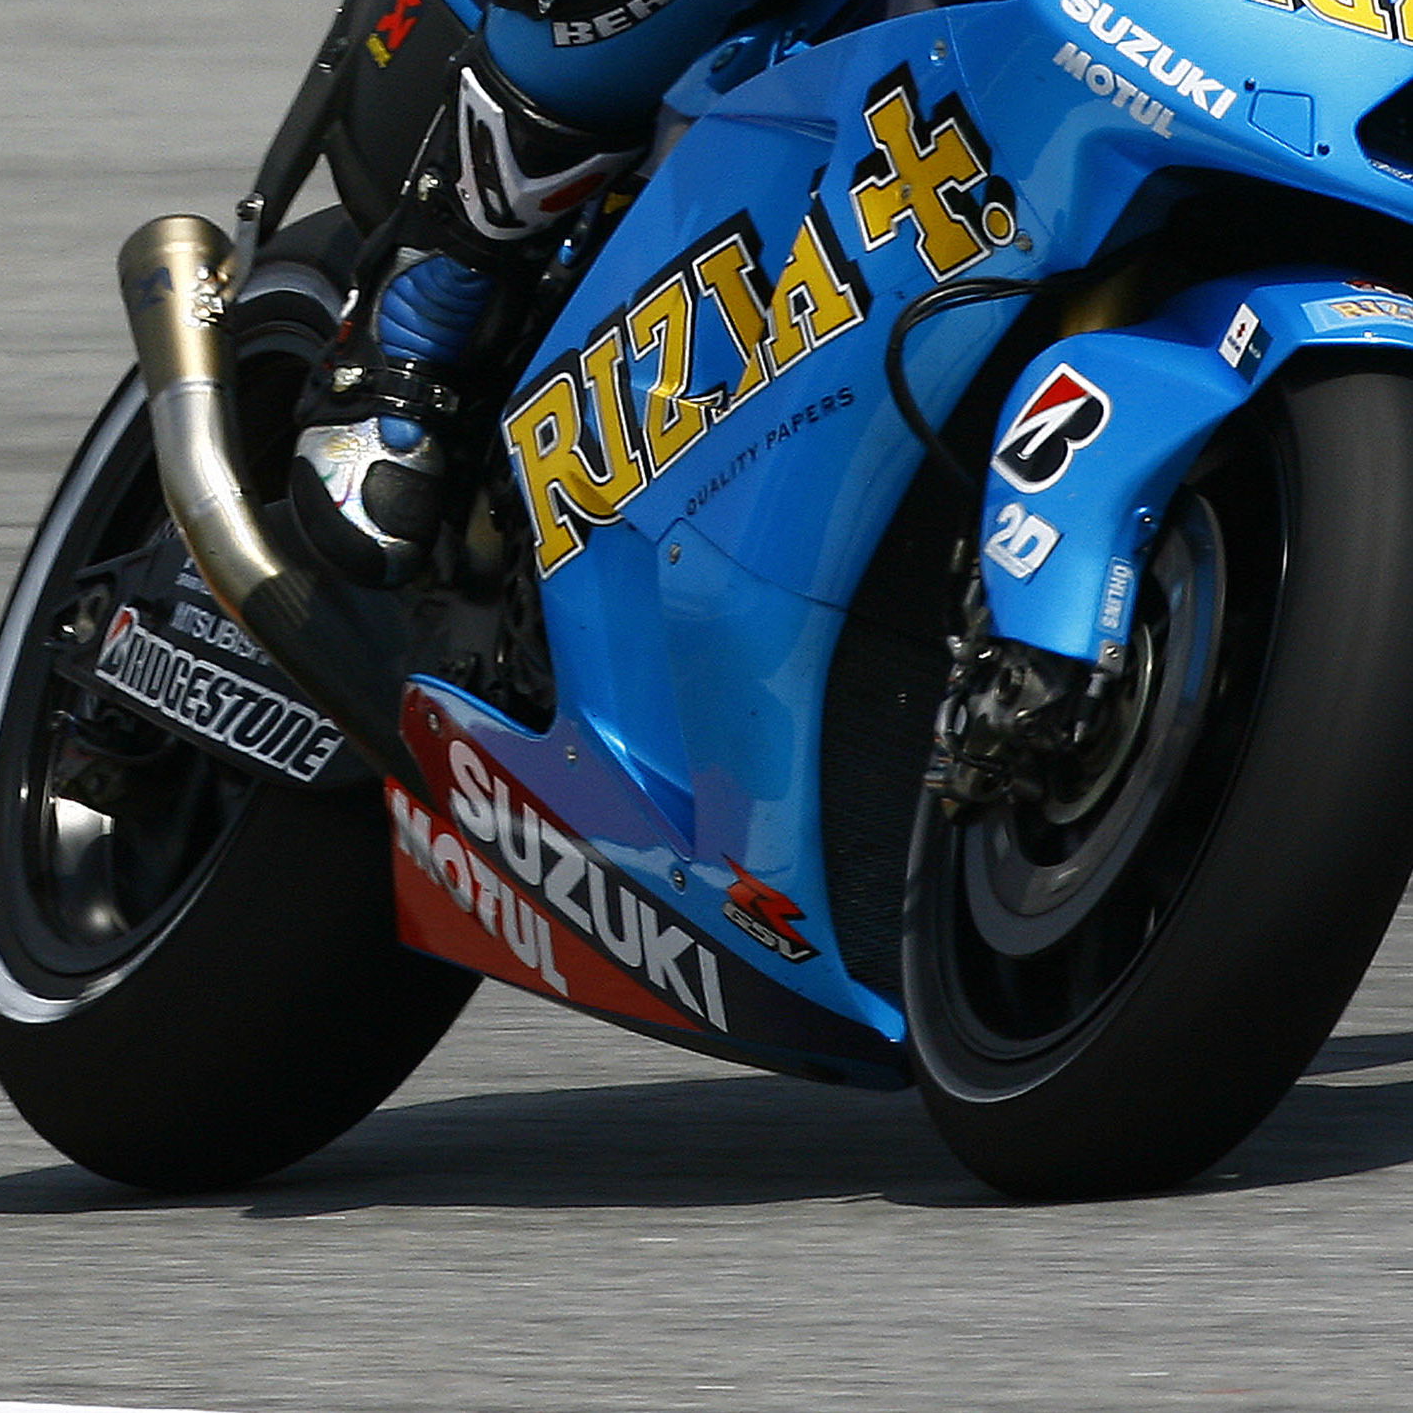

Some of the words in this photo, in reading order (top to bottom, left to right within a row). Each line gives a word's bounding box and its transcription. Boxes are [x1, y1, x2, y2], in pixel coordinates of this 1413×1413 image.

[1052, 42, 1177, 140] MOTUL
[686, 442, 759, 516] QUALITY
[763, 386, 855, 451] PAPERS
[95, 607, 344, 781] BRIDGESTONE
[391, 787, 569, 997] MOTUL
[448, 740, 727, 1033] SUZUKI
